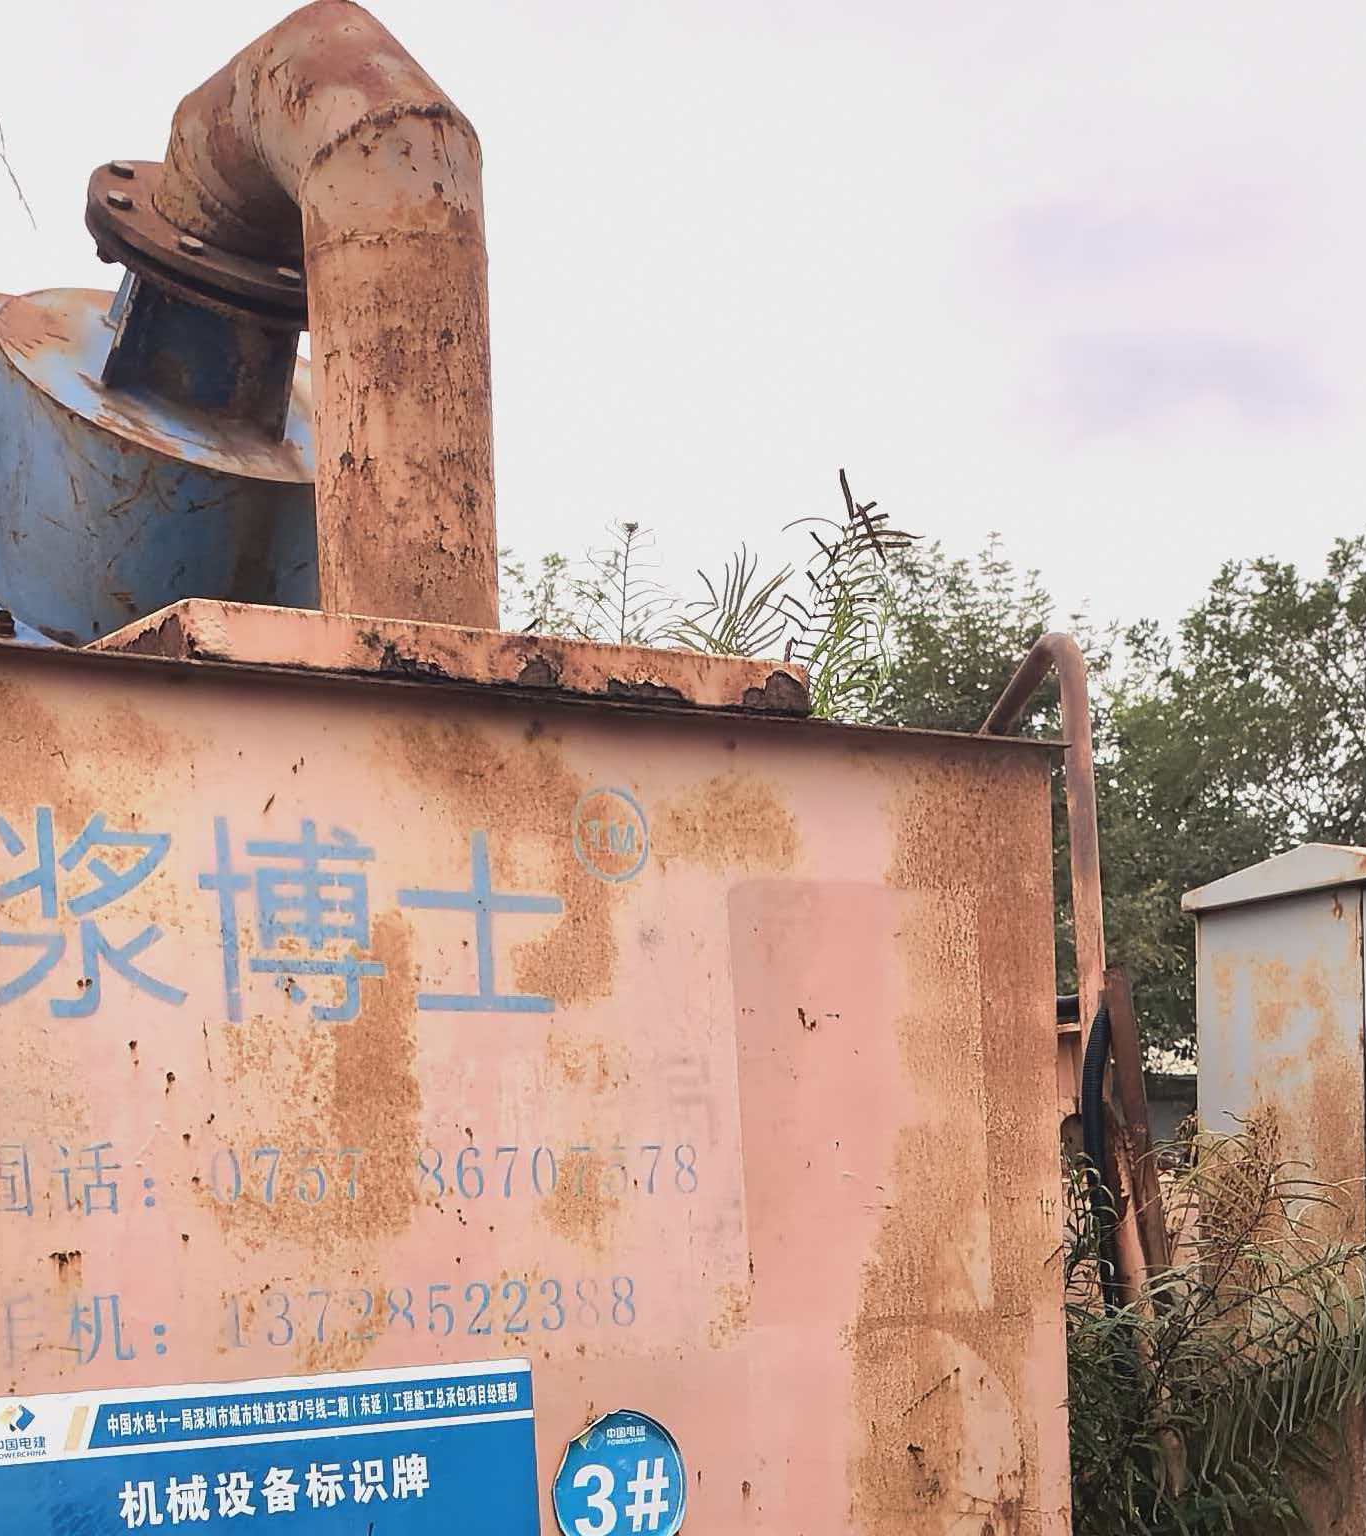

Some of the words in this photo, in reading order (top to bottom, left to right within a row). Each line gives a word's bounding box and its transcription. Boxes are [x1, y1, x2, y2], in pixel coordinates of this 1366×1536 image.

[118, 1453, 431, 1529] 机械设备标识牌
